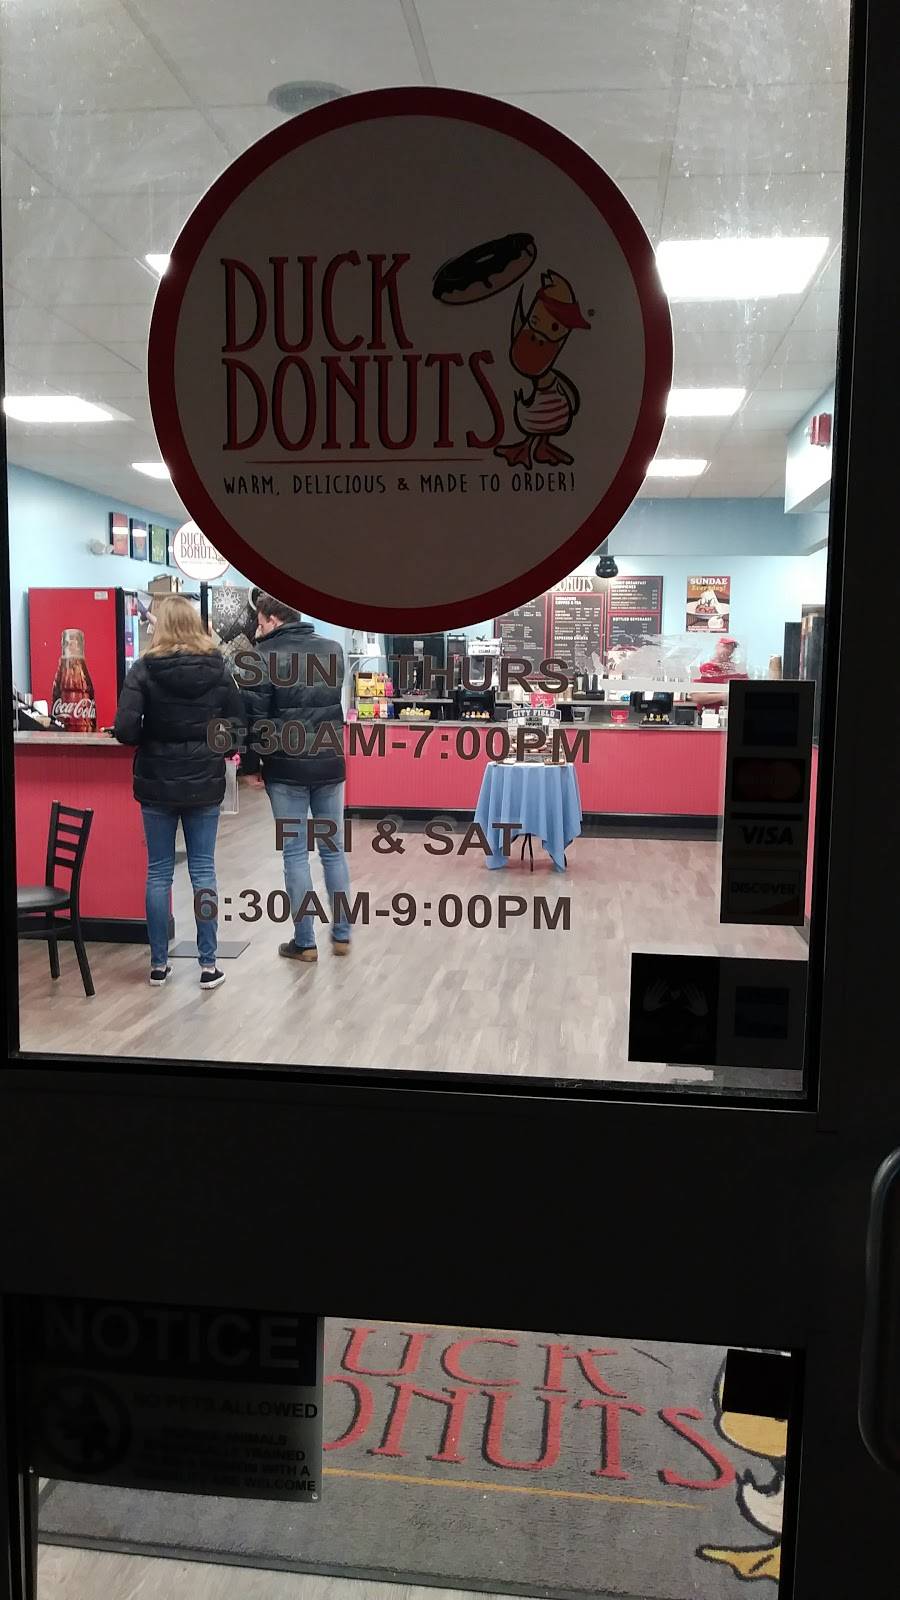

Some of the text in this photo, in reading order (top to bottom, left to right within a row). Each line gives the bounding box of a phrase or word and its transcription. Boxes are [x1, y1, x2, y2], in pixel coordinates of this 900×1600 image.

[220, 250, 413, 354] DUCK
[221, 350, 506, 451] DONUTS
[223, 472, 576, 497] WARM, DELICIOUS & MADE TO ORDER!
[180, 532, 206, 546] DUCK
[553, 576, 594, 593] ONUTS
[690, 577, 728, 585] SUNDAE
[233, 651, 570, 695] SUN THURS
[512, 709, 556, 718] CITY FIELD
[206, 717, 592, 764] 6:30AM-7:00PM
[275, 817, 523, 857] FRI & SAT
[739, 823, 795, 845] VISA
[193, 887, 573, 932] 6:30AM-9:00PM
[43, 1300, 303, 1369] NOTICE
[340, 1326, 627, 1400] UCK
[221, 1399, 319, 1419] ALLOWED
[300, 1464, 311, 1477] A
[244, 1477, 316, 1492] WELCOME
